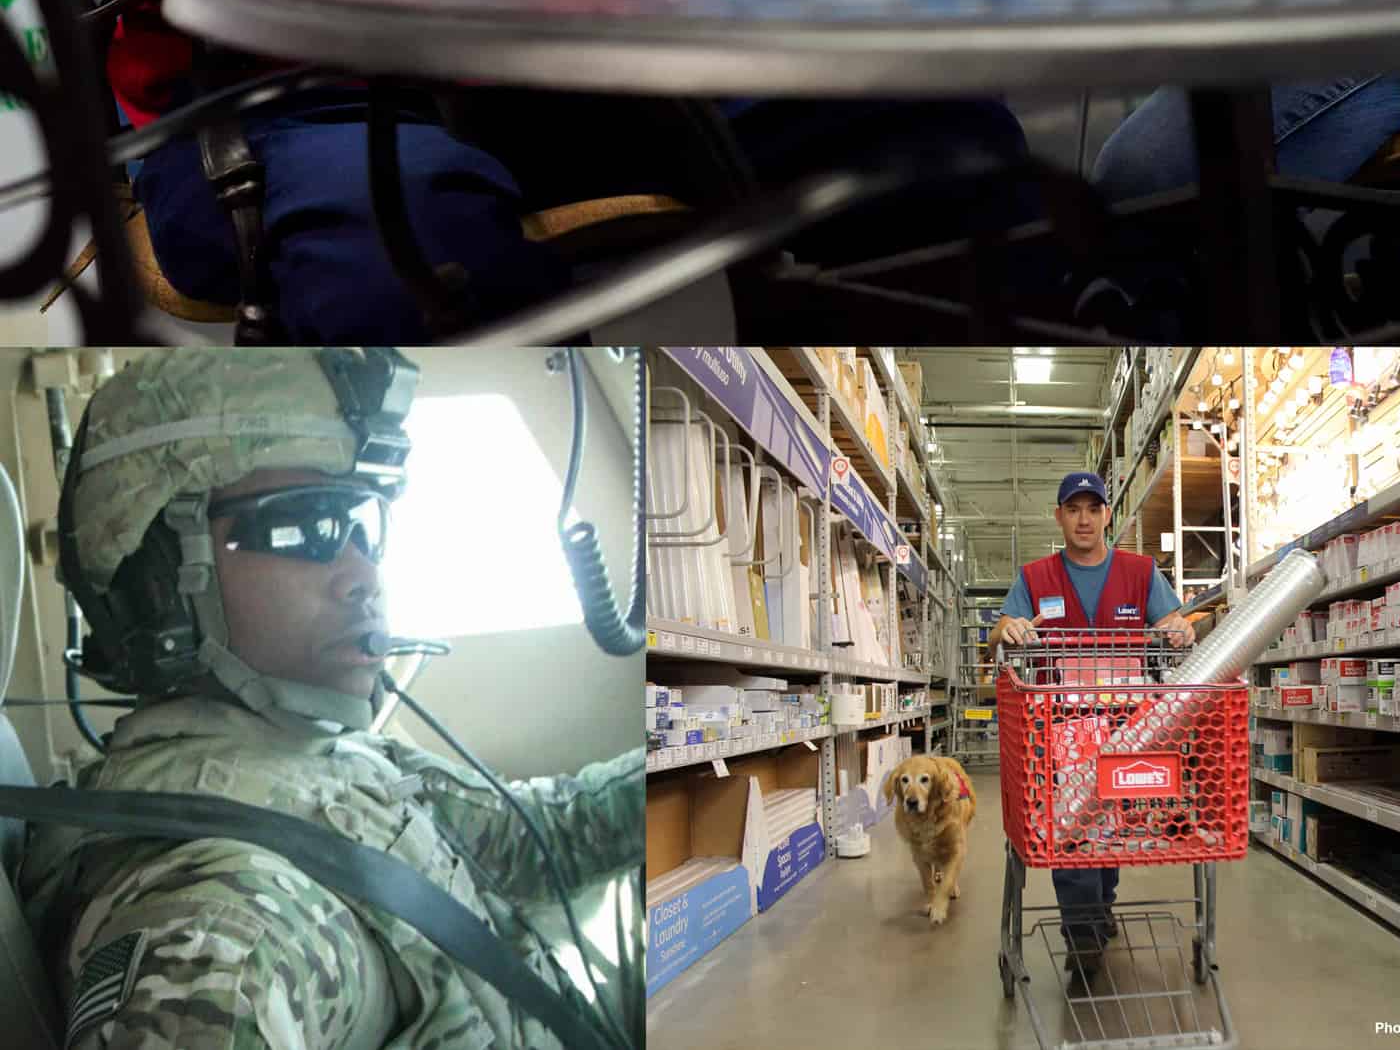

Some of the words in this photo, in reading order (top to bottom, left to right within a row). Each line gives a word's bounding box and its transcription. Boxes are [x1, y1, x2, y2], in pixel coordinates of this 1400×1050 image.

[1118, 771, 1165, 785] LOWE'S
[655, 896, 681, 926] Closet
[655, 917, 689, 948] Laundry
